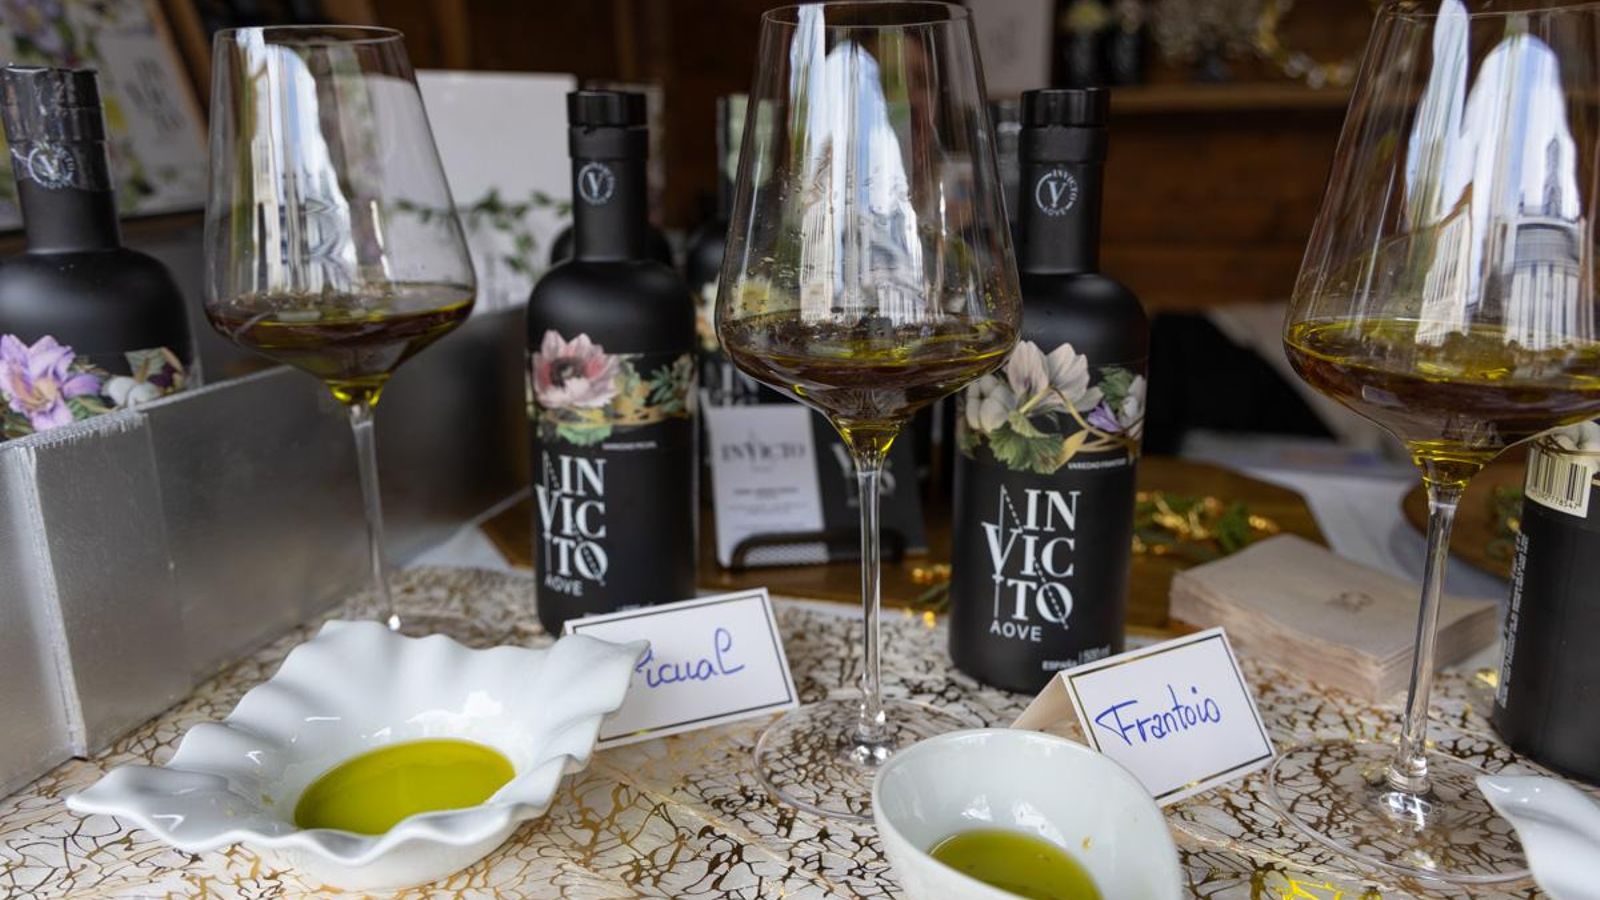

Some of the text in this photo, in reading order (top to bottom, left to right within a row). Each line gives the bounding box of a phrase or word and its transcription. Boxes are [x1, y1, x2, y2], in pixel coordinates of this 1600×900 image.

[1047, 180, 1067, 208] V
[558, 455, 607, 496] IN
[534, 483, 607, 540] VIC
[1024, 488, 1081, 532] IN
[552, 536, 609, 581] TO
[981, 521, 1076, 580] VIC
[544, 574, 583, 596] AOVE
[1006, 579, 1073, 623] TO
[990, 620, 1042, 642] AOVE
[634, 627, 745, 688] icual
[1095, 683, 1221, 746] Frantoio
